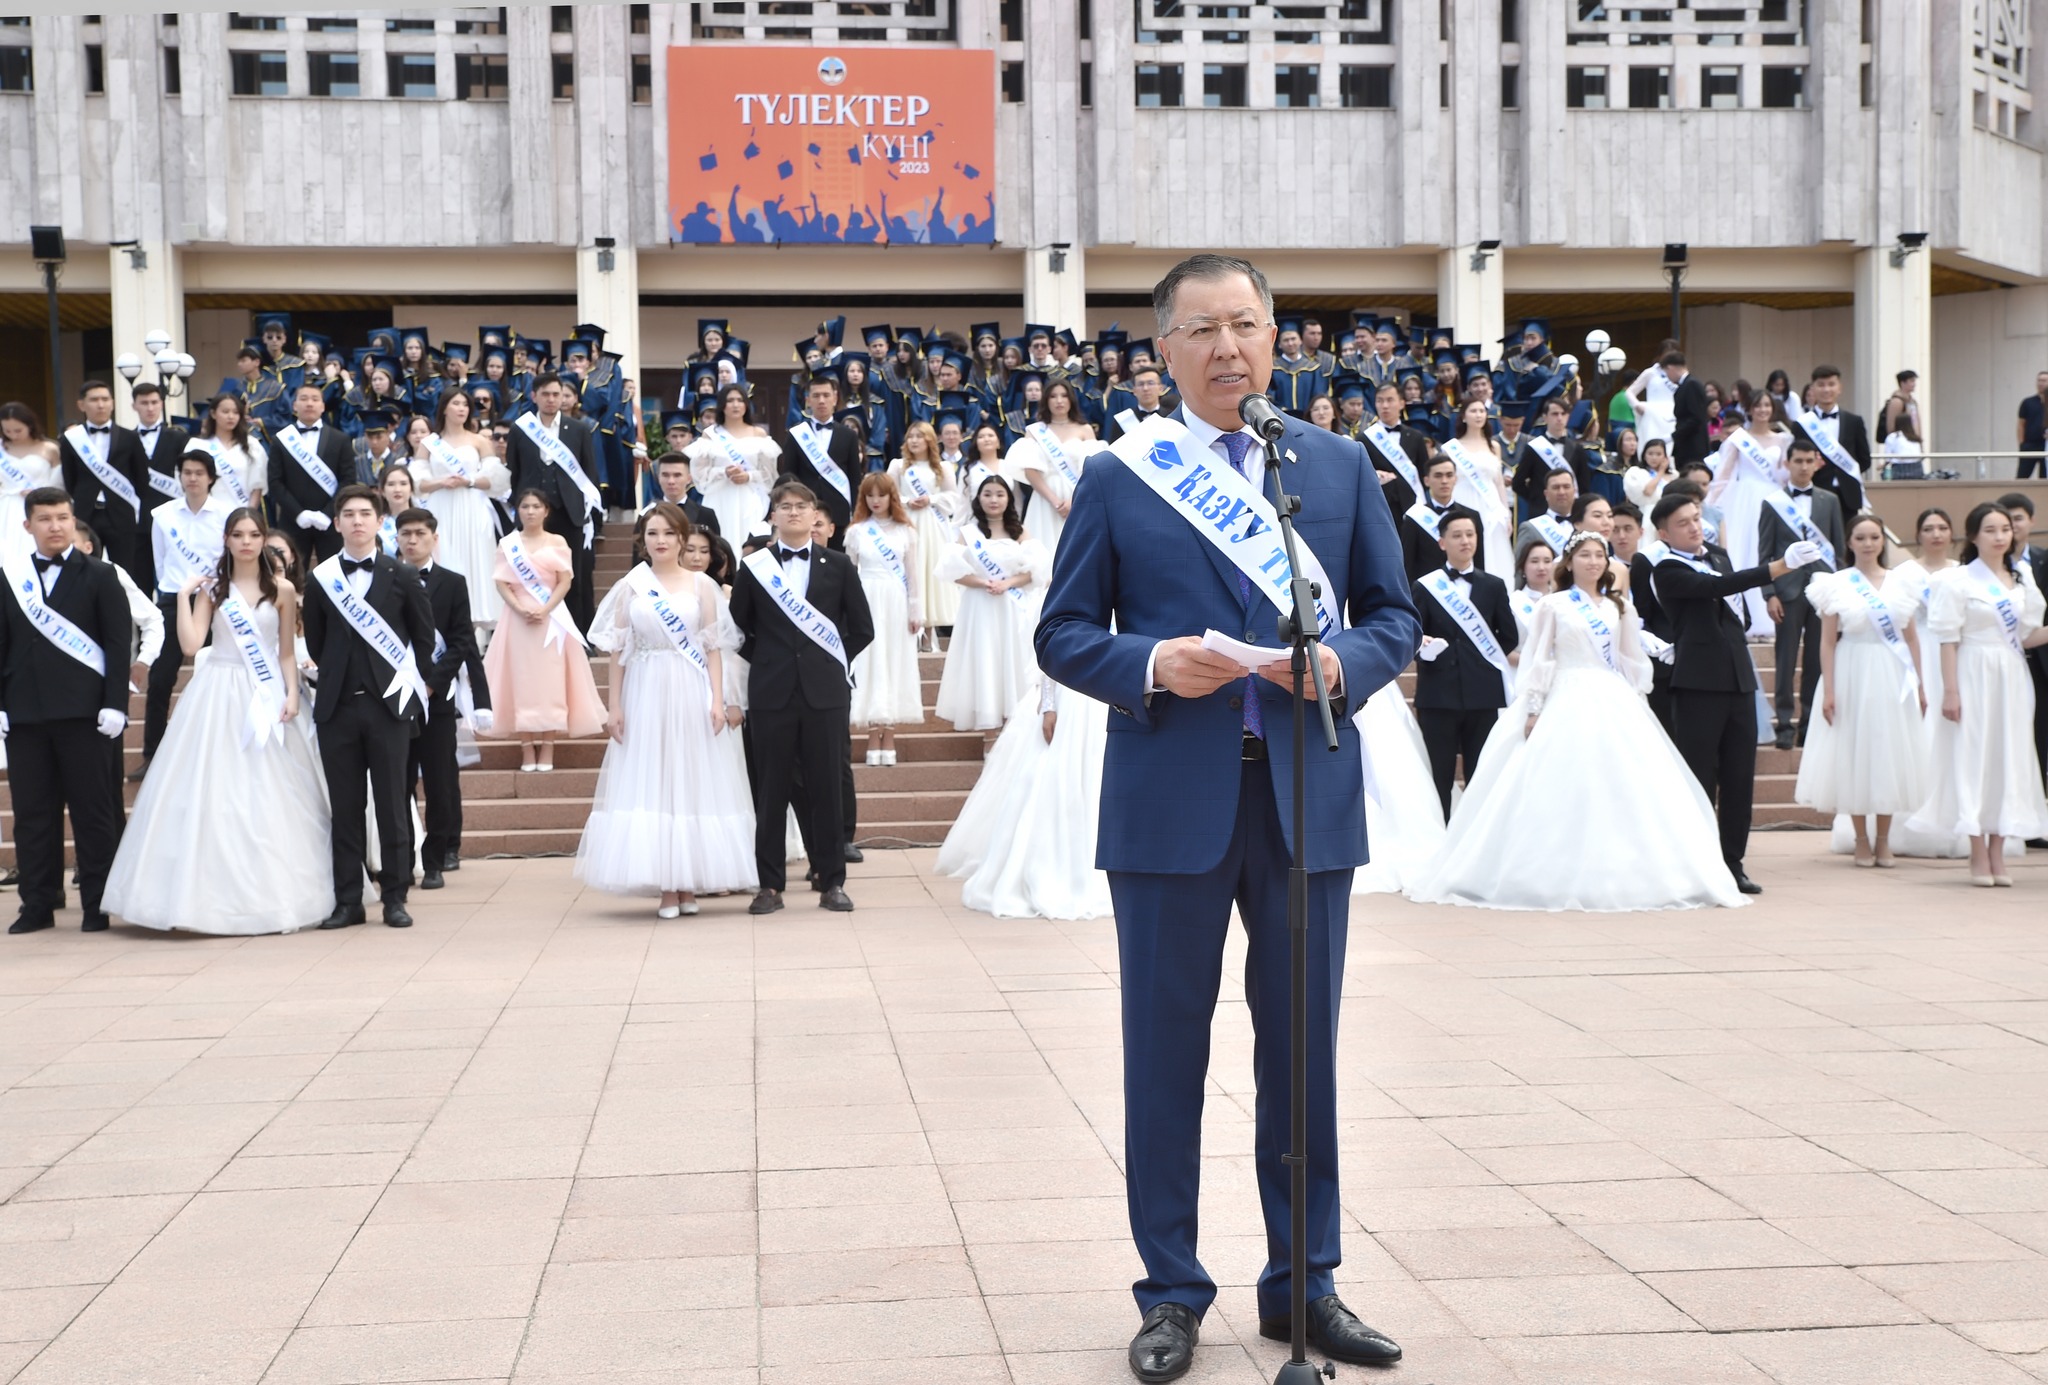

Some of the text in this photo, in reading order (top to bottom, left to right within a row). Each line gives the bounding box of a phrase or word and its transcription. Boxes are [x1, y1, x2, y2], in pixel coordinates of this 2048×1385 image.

[734, 93, 930, 128] ТҮЛЕКТЕР
[862, 134, 930, 161] КҮНІ
[899, 161, 930, 174] 2023
[1172, 463, 1272, 544] ҚАЗҰУ
